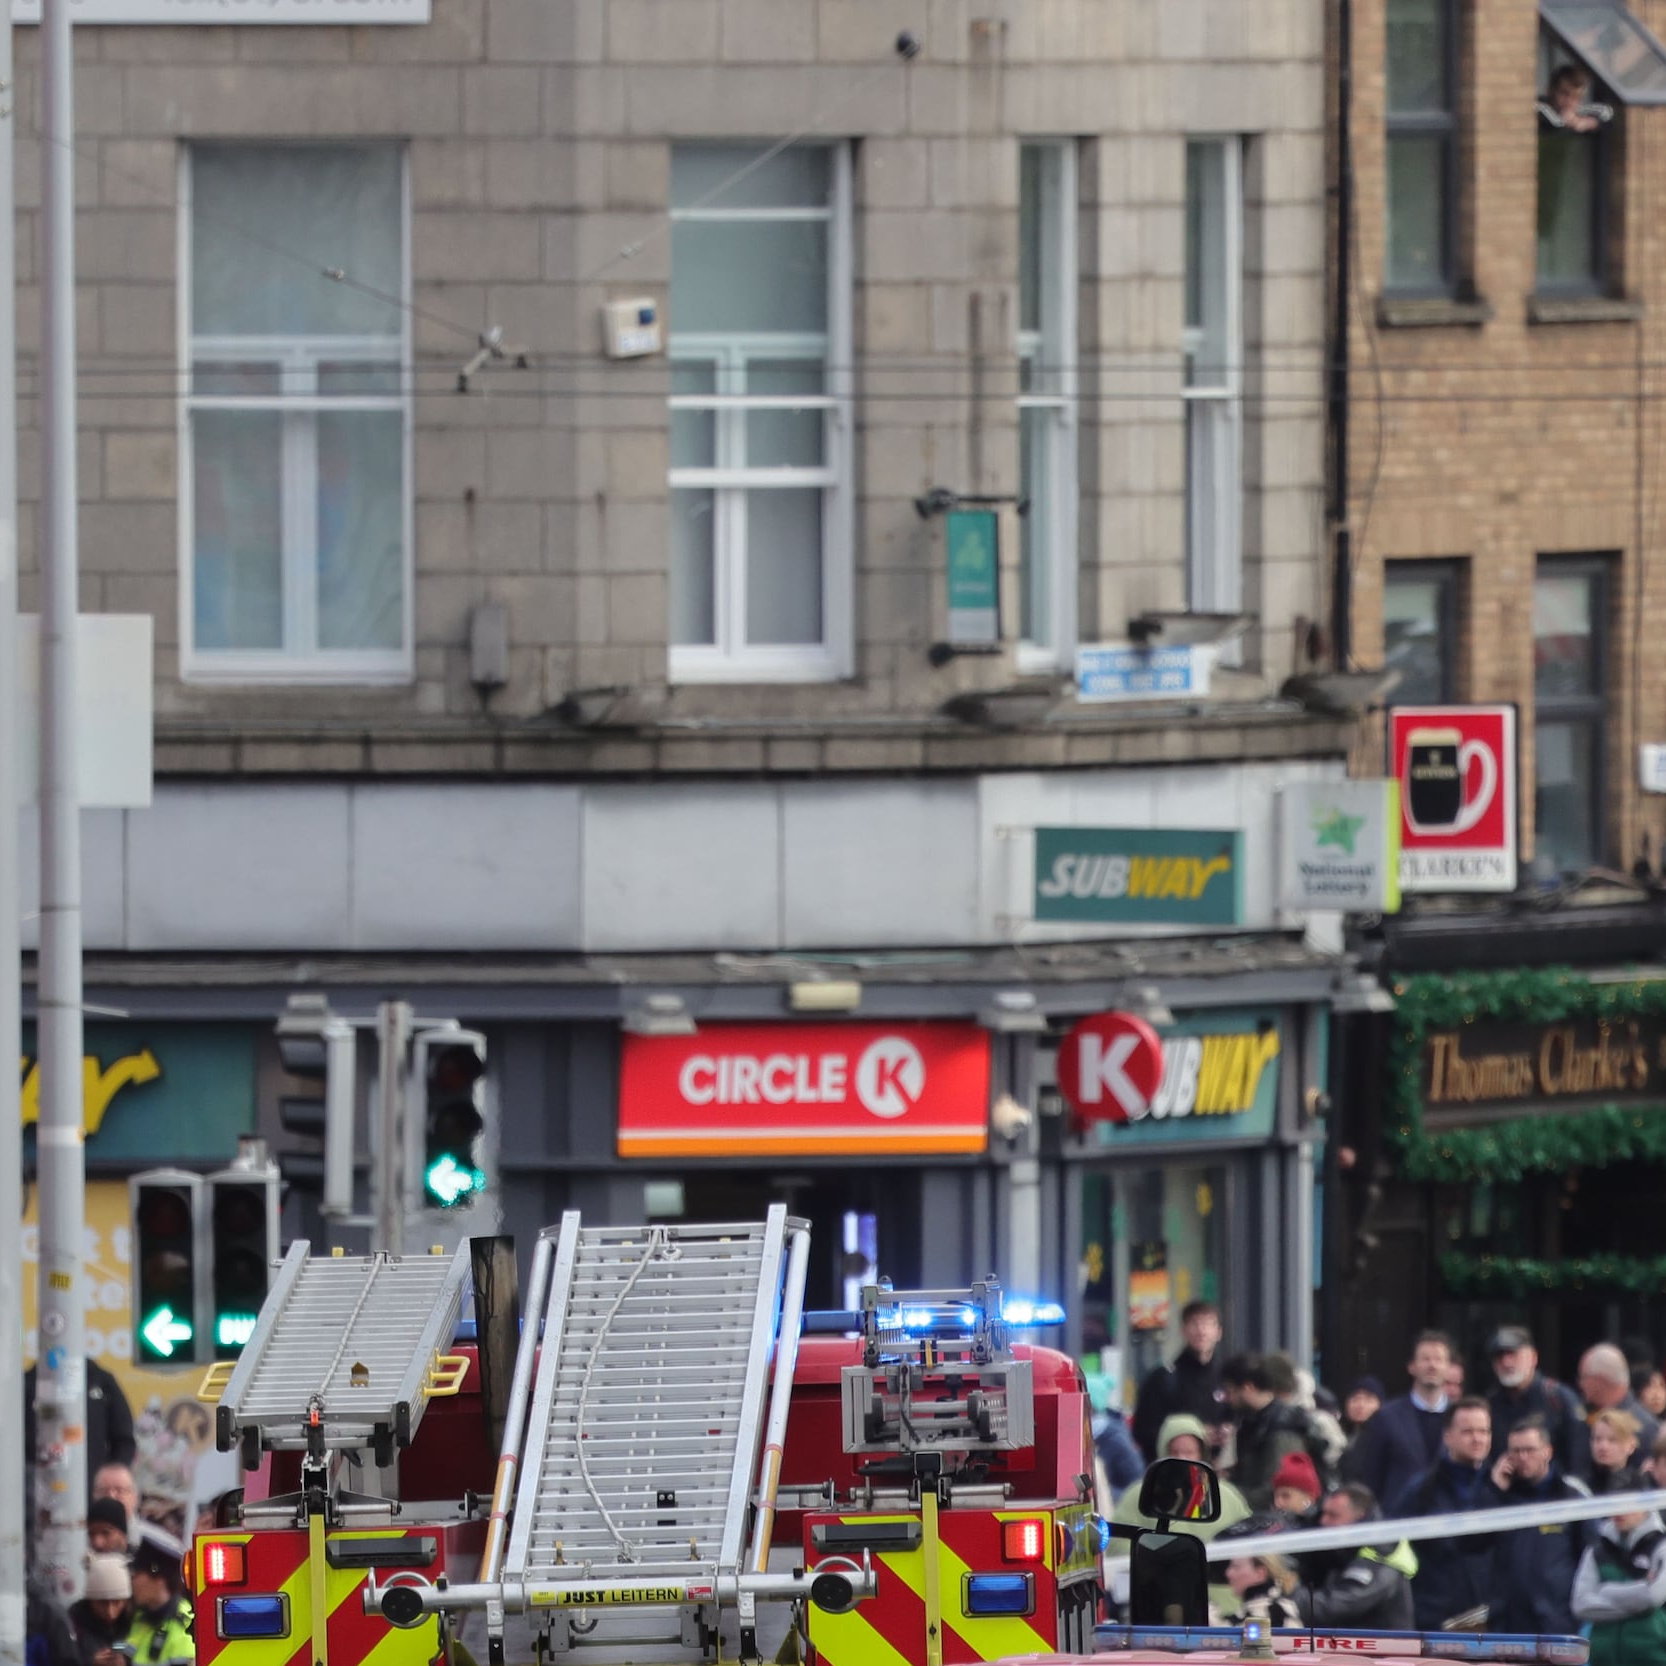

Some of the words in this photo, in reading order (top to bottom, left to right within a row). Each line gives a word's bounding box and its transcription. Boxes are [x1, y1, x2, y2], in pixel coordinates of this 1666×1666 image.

[1038, 853, 1230, 900] SUBWAY
[679, 1053, 848, 1105] CIRCLE
[1078, 1032, 1149, 1120] K
[1150, 1030, 1280, 1120] UBWAY
[1429, 1033, 1533, 1102] Thomas
[563, 1590, 606, 1604] JUST
[611, 1588, 678, 1602] LEITERN
[1293, 1637, 1377, 1651] FIRE
